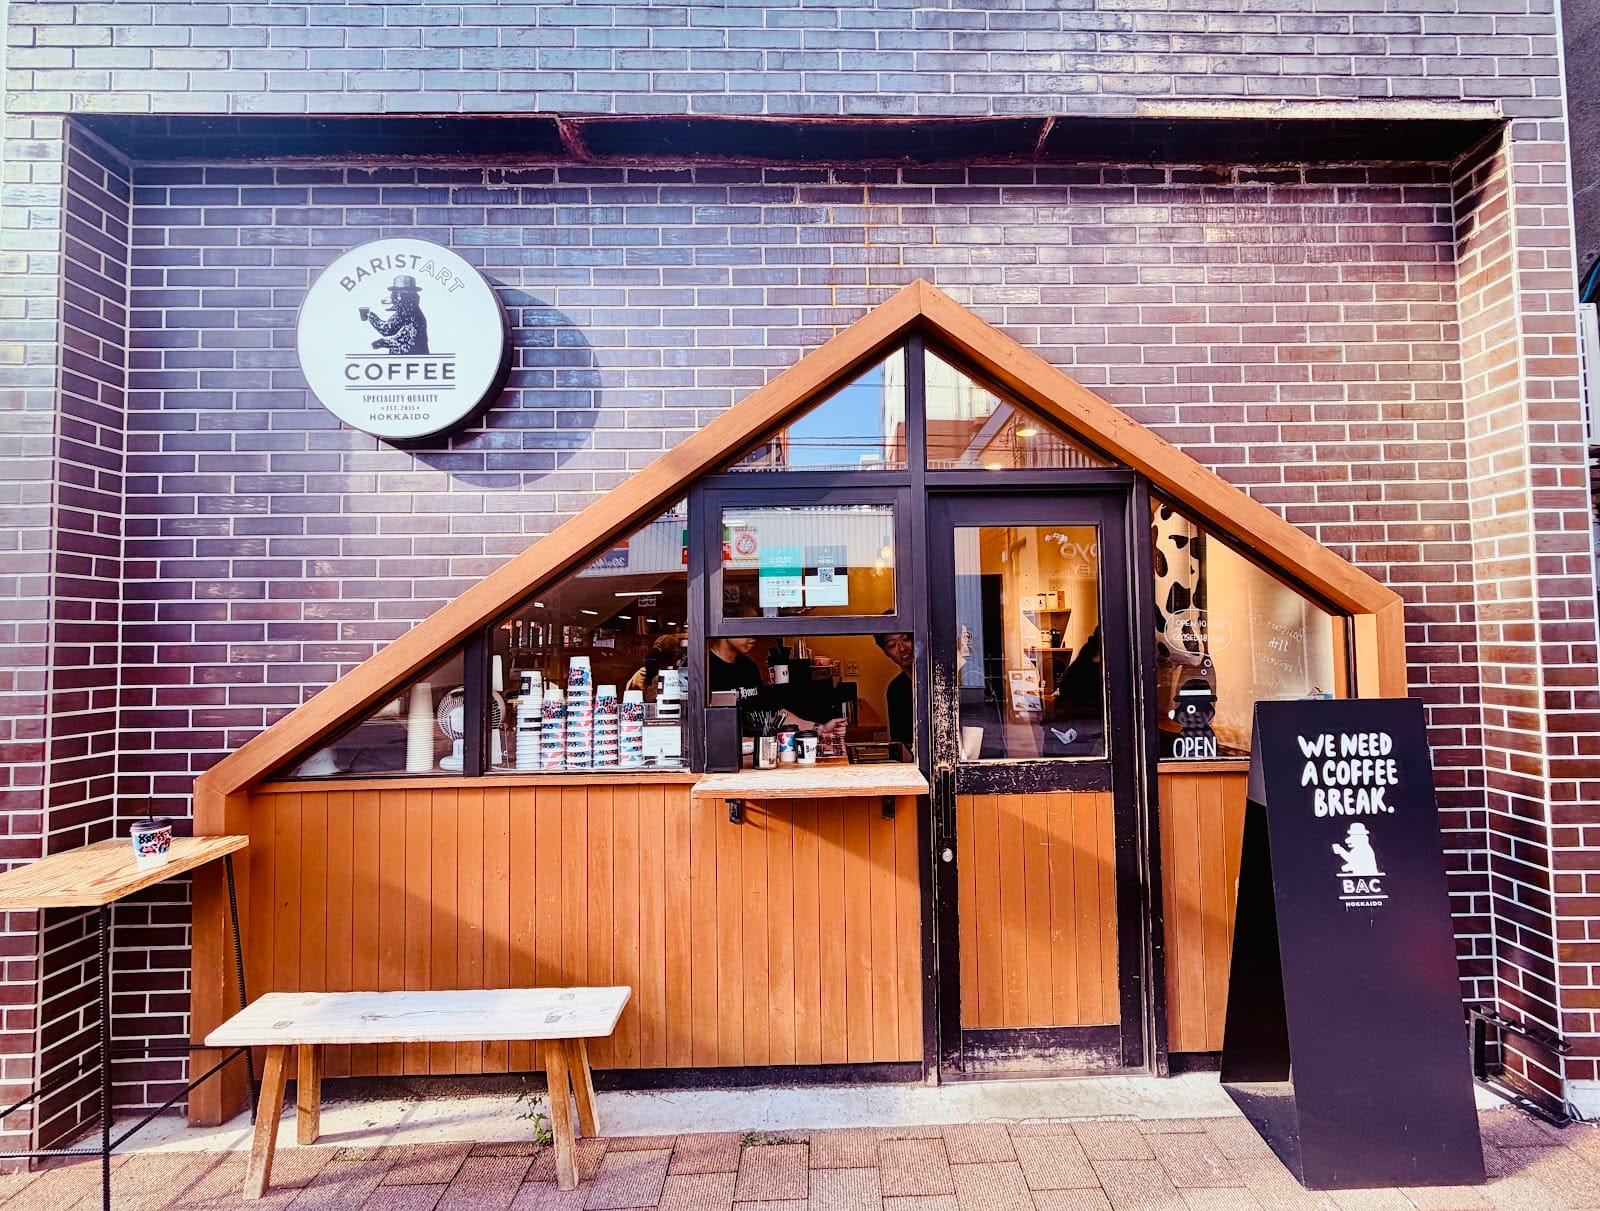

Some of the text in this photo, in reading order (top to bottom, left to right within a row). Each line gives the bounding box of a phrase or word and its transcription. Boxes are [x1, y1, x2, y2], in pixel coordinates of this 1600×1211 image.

[340, 253, 465, 293] BARISTART
[345, 363, 456, 381] COFFEE
[362, 394, 439, 403] SPECIALITY QUALITY
[369, 413, 430, 421] HOKKAIDO
[1172, 736, 1217, 758] OPEN
[1297, 732, 1393, 758] WE NEED
[1301, 758, 1399, 787] A COFFEE
[1314, 786, 1395, 817] BREAK.
[1342, 878, 1382, 893] BAC
[1345, 900, 1383, 908] HOKKAIDO
